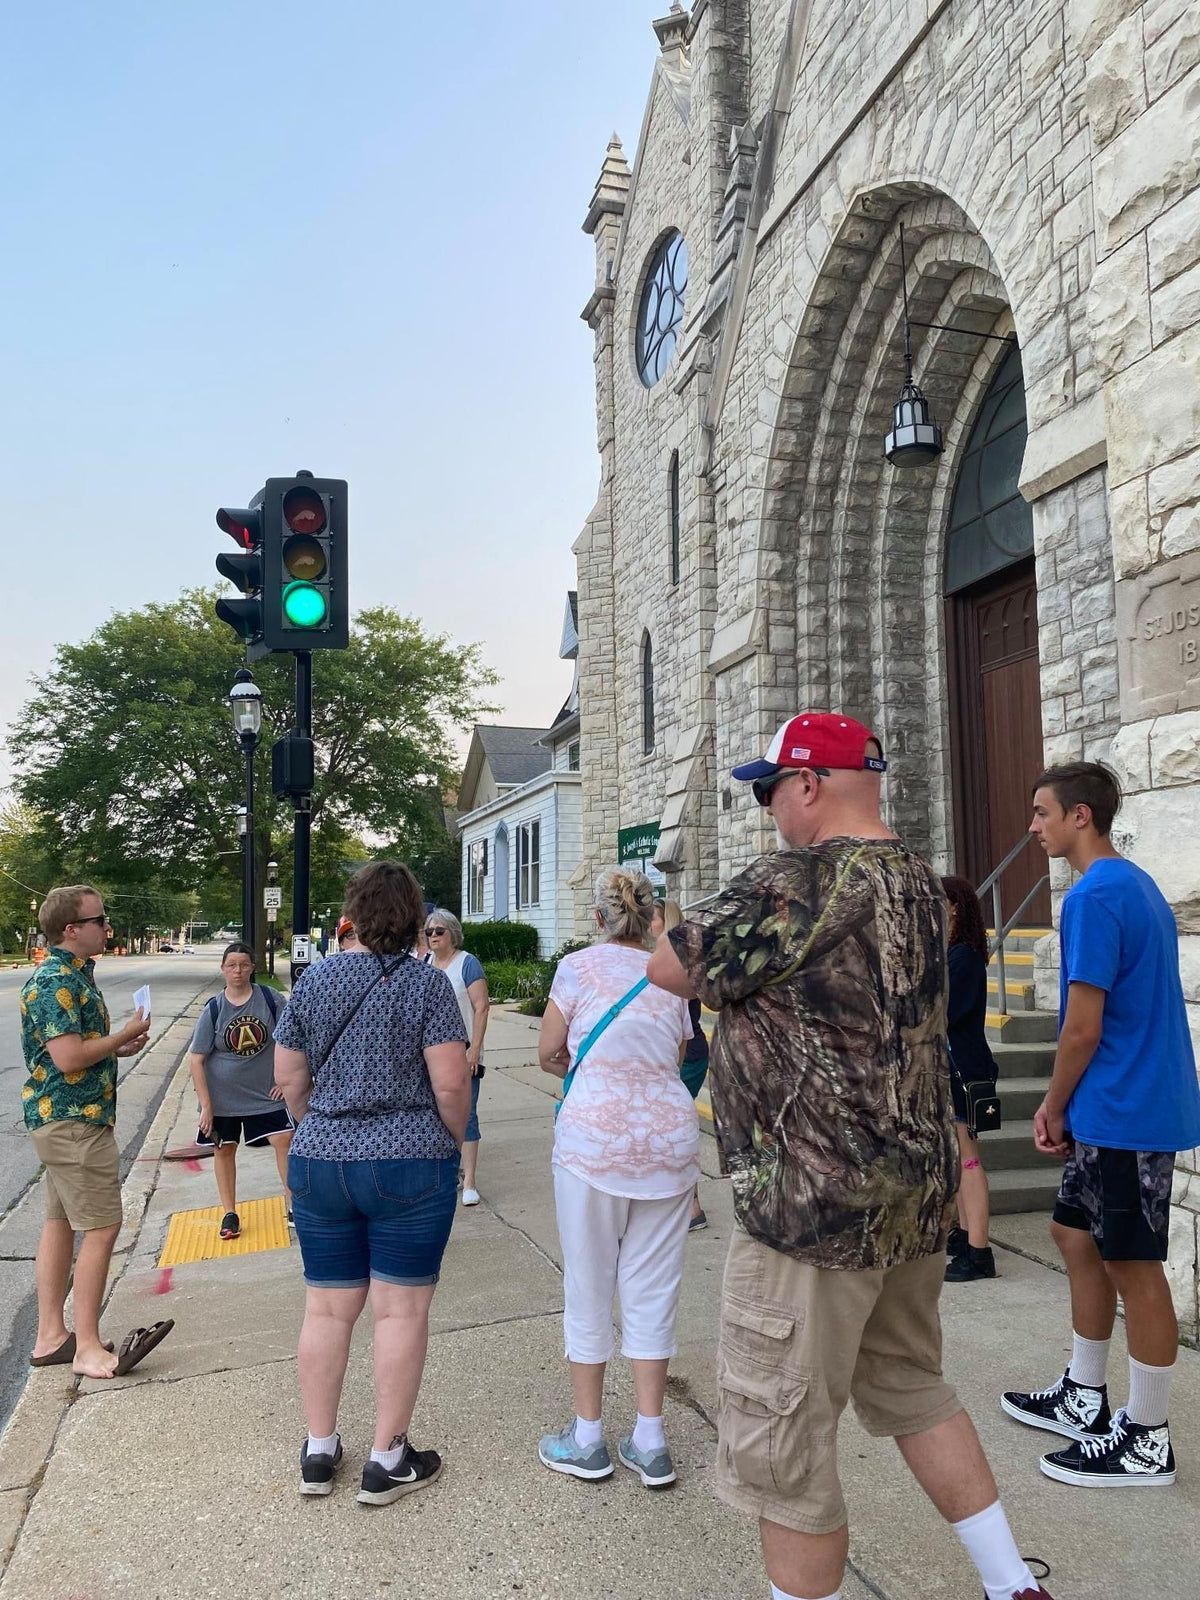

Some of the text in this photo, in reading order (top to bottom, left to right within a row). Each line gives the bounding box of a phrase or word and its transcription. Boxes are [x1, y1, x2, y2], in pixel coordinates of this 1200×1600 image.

[1179, 640, 1198, 666] 18
[266, 898, 279, 906] 25
[229, 1016, 260, 1030] ATLANTA
